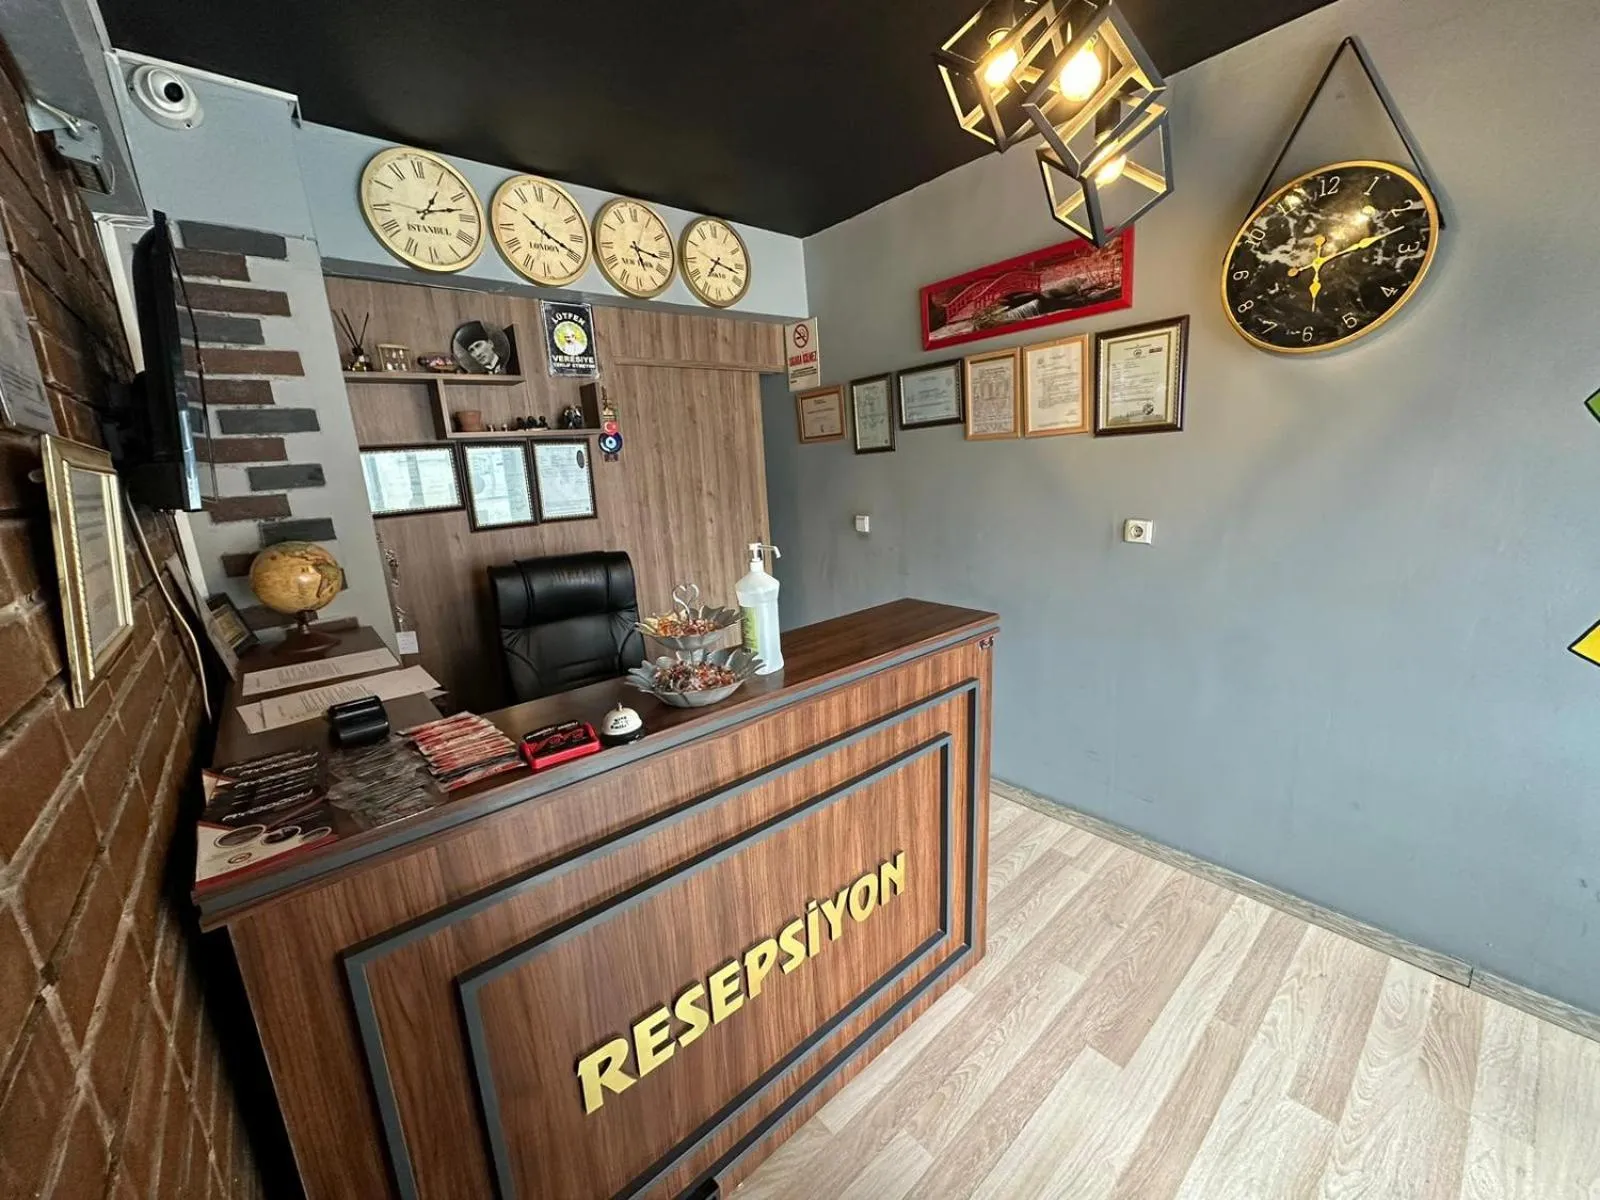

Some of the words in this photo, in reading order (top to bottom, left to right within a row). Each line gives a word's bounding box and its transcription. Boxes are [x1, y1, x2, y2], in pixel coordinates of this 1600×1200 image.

[1318, 176, 1342, 197] 12
[1363, 176, 1380, 196] 1
[1390, 199, 1412, 218] 2
[1244, 228, 1266, 247] 10
[529, 241, 560, 254] LONDON
[1398, 241, 1420, 254] 3
[1232, 270, 1250, 281] 9
[1380, 286, 1398, 298] 4
[1238, 300, 1254, 314] 8
[1261, 319, 1278, 334] 7
[1342, 312, 1358, 328] 5
[1302, 326, 1314, 342] 6
[576, 850, 906, 1115] RESEPSİYON
